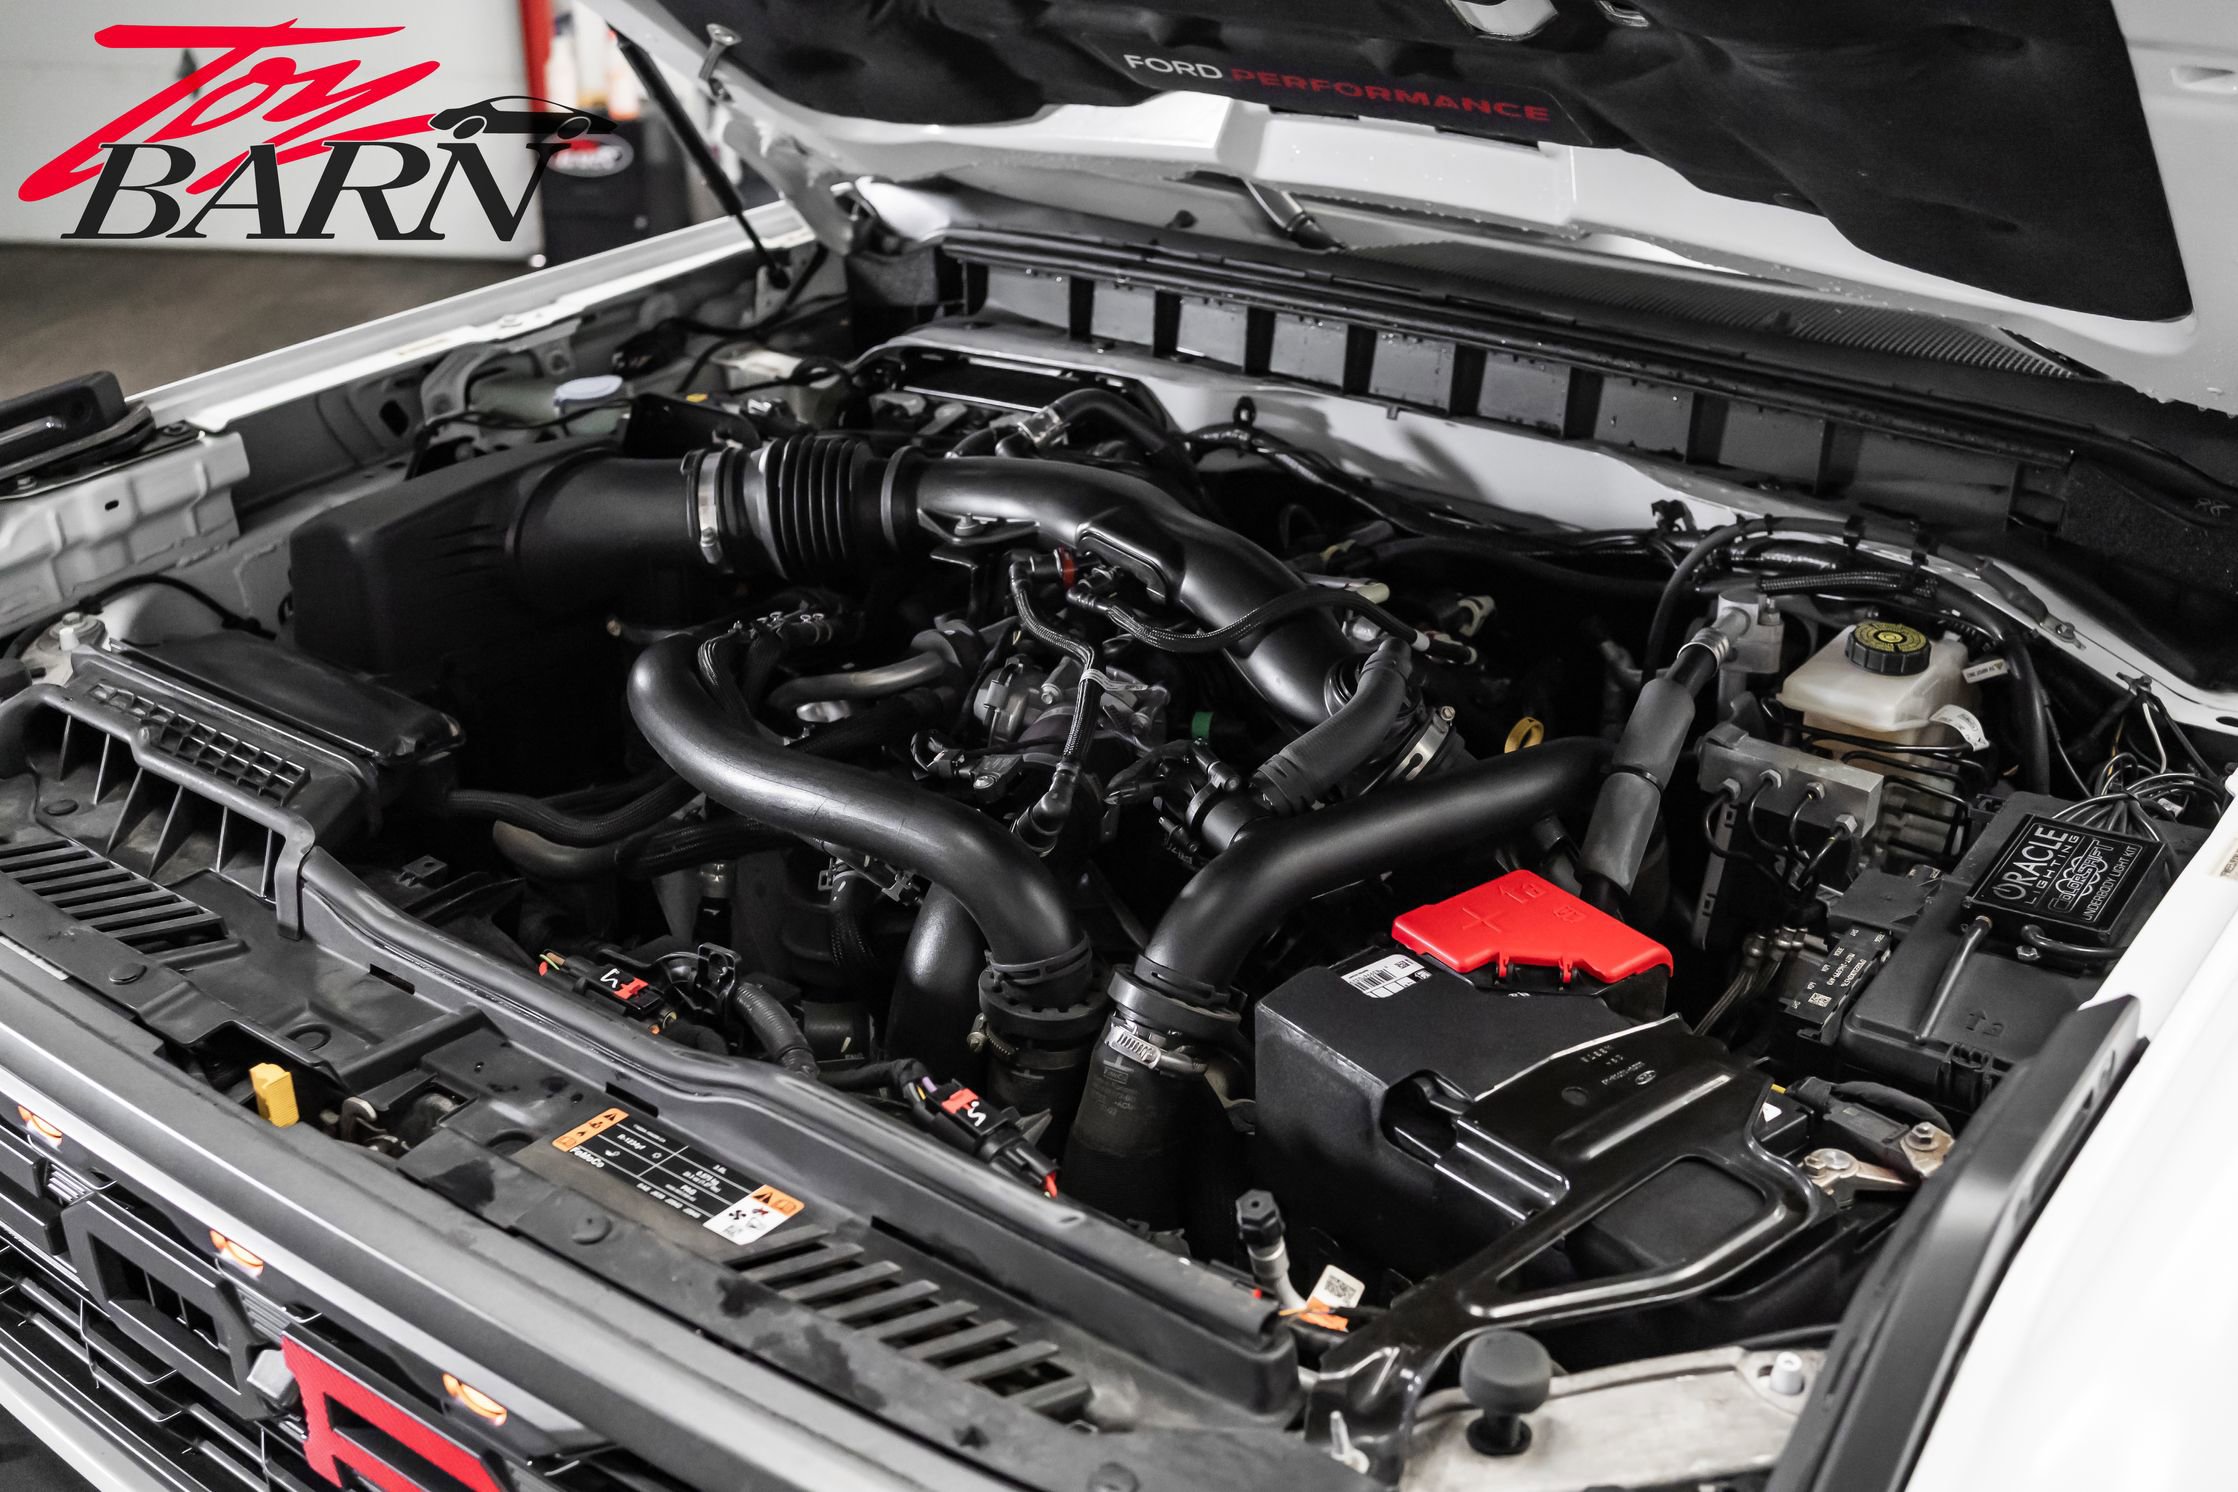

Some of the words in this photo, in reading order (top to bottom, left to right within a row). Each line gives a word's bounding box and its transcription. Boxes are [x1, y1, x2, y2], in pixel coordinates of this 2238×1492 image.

[1123, 53, 1223, 80] FORD
[1231, 67, 1550, 122] PERFORMANCE
[1992, 826, 2069, 900] ORACLE
[2024, 834, 2080, 905] LIGHTING
[2082, 876, 2117, 921] UNDERBODY
[2111, 856, 2130, 879] LIGHT
[2125, 845, 2139, 860] KIT
